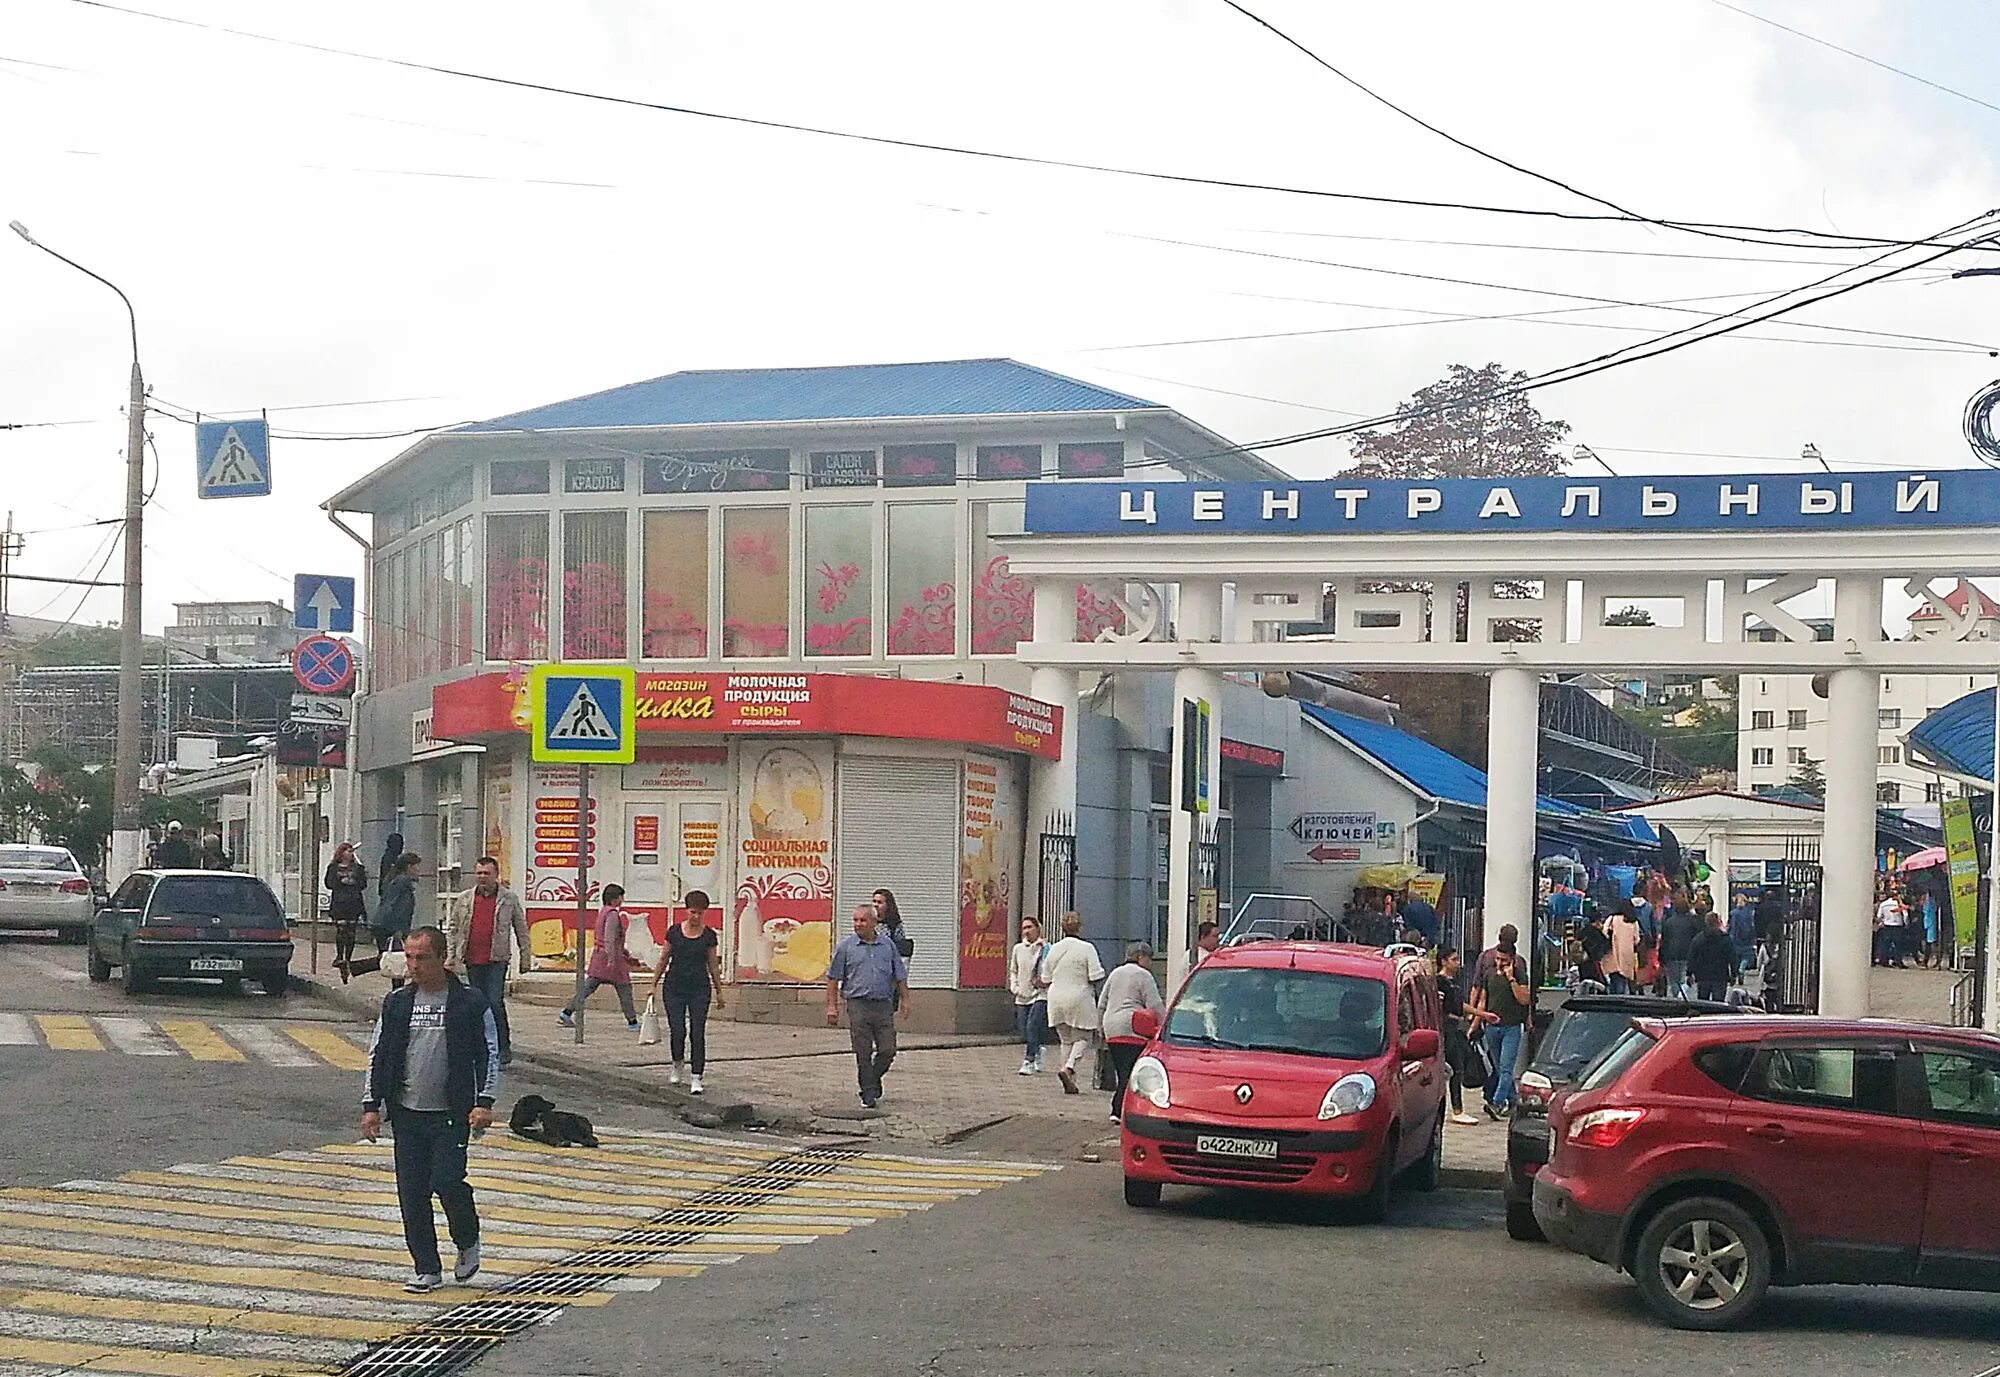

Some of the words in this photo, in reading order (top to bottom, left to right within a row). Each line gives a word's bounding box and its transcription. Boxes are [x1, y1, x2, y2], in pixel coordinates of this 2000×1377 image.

[826, 454, 862, 469] САЛОН
[572, 475, 620, 489] КРАСОТЫ
[1120, 475, 1940, 523] ЦЕНТРАЛЬНЫЙ
[1236, 576, 1819, 643] РЫНОК
[645, 680, 708, 692] магазин
[728, 676, 807, 688] МОЛОЧНАЯ
[724, 690, 810, 704] ПРОДУКЦИЯ
[740, 705, 788, 717] СЫРЫ
[1009, 695, 1052, 718] МОЛОЧНАЯ
[742, 718, 802, 727] производителя
[1006, 710, 1053, 735] ПРОДУКЦИЯ
[660, 767, 691, 777] Добро
[541, 800, 576, 808] МОЛОКО
[1304, 816, 1373, 825] ИЗГОТОВЛЕНИЕ
[540, 829, 575, 837] СМЕТАНА
[1304, 827, 1373, 840] КЛЮЧЕЙ
[742, 840, 829, 854] СОЦИАЛЬНАЯ
[746, 855, 822, 868] ПРОГРАММА
[1200, 1138, 1252, 1154] О422НК
[1254, 1140, 1274, 1153] 777
